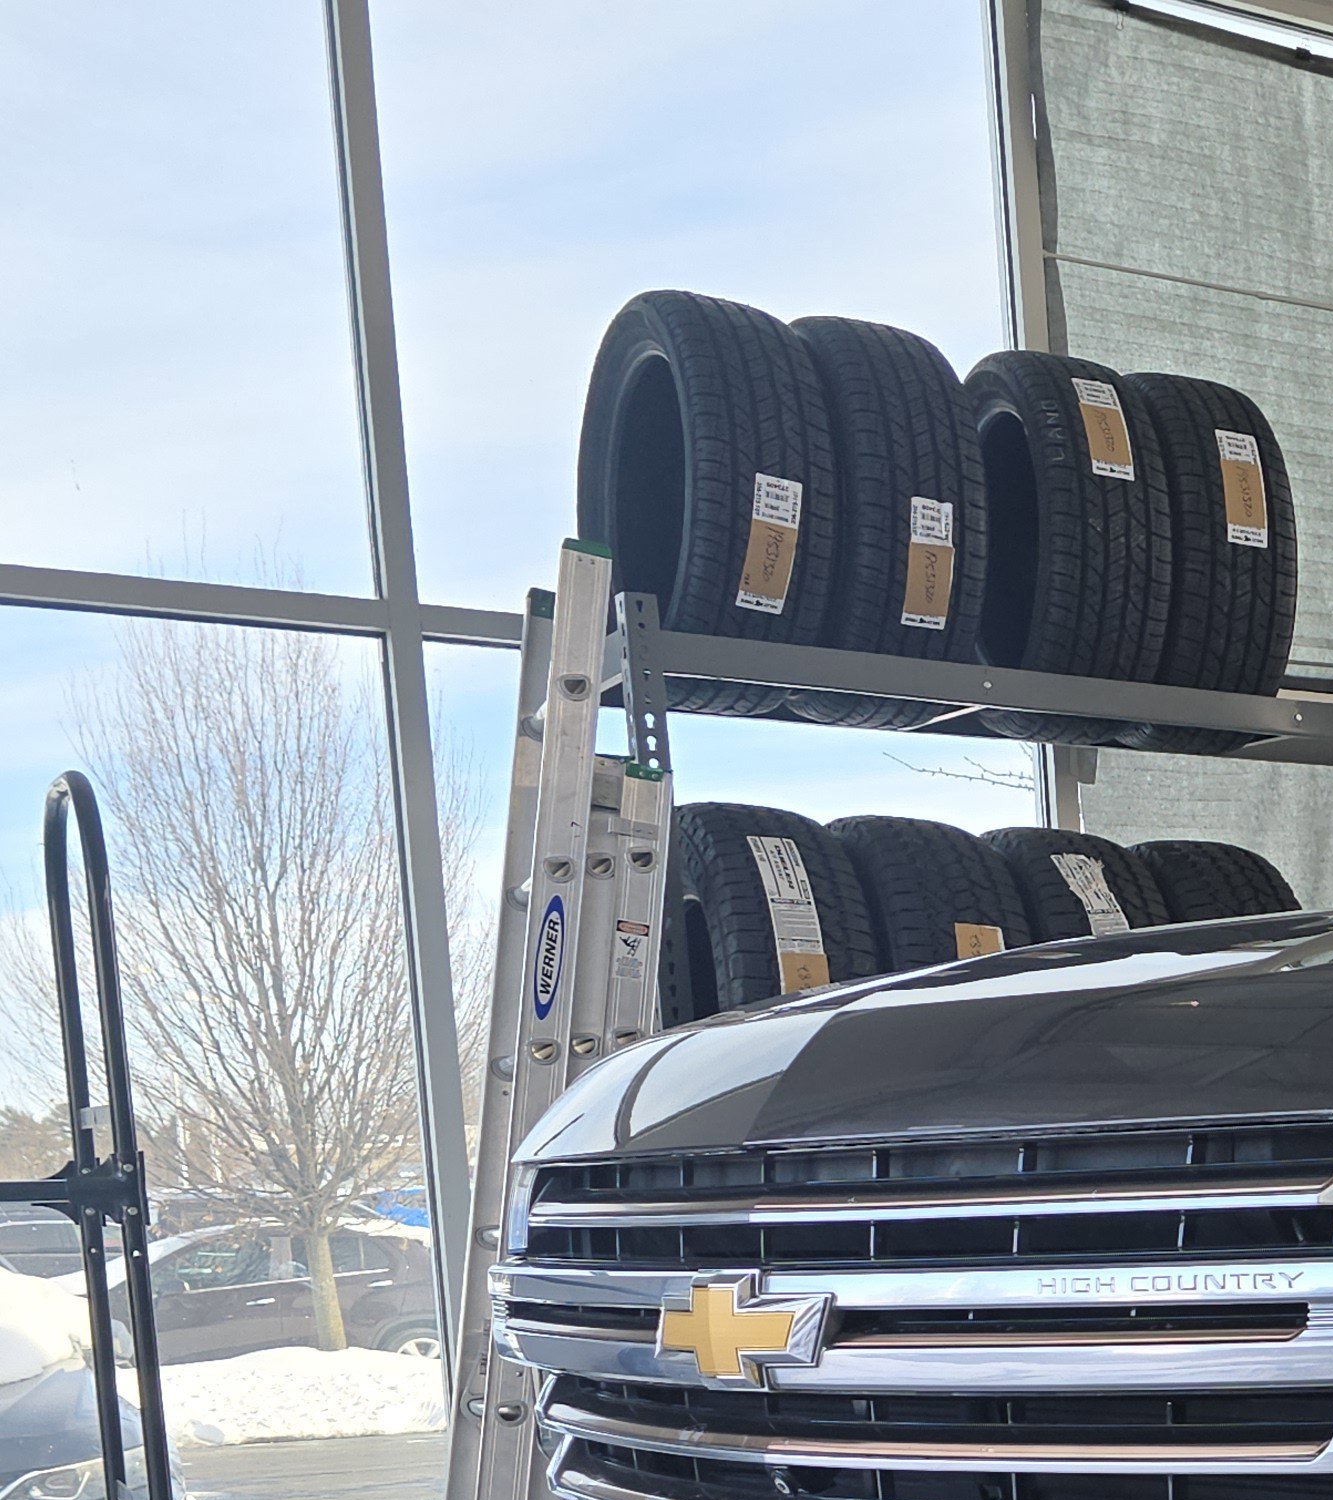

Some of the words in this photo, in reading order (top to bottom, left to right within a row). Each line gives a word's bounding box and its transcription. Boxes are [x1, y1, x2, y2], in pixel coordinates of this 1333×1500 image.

[539, 918, 560, 996] WERNER
[1037, 1276, 1116, 1295] HIGH
[1130, 1271, 1305, 1293] COUNTRY
